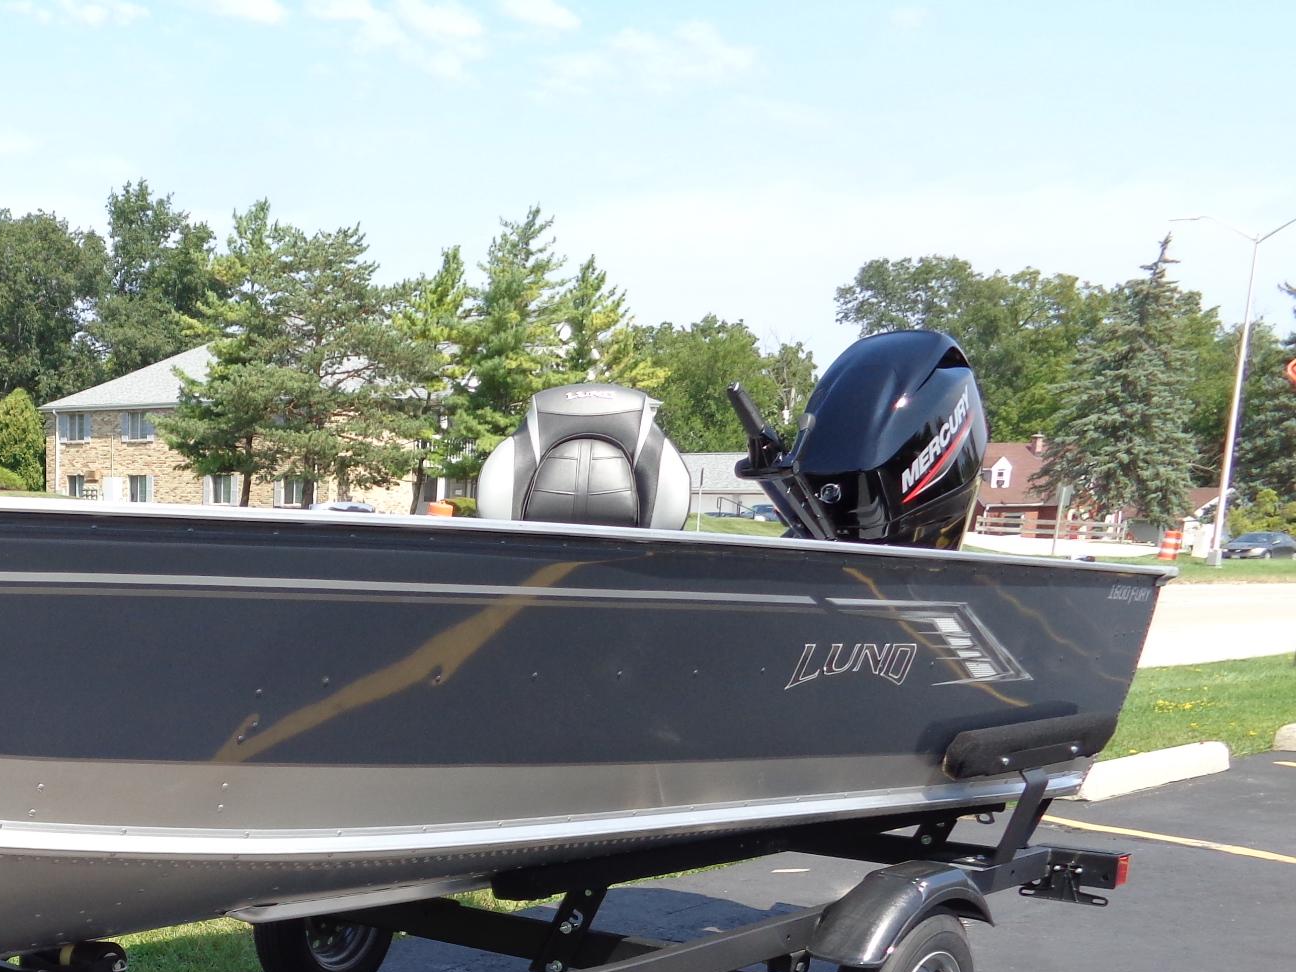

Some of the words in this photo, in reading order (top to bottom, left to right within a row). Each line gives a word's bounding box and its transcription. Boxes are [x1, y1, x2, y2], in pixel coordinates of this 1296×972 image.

[901, 384, 970, 494] MERCURY
[1106, 584, 1131, 600] 1600
[784, 643, 917, 690] LUND
